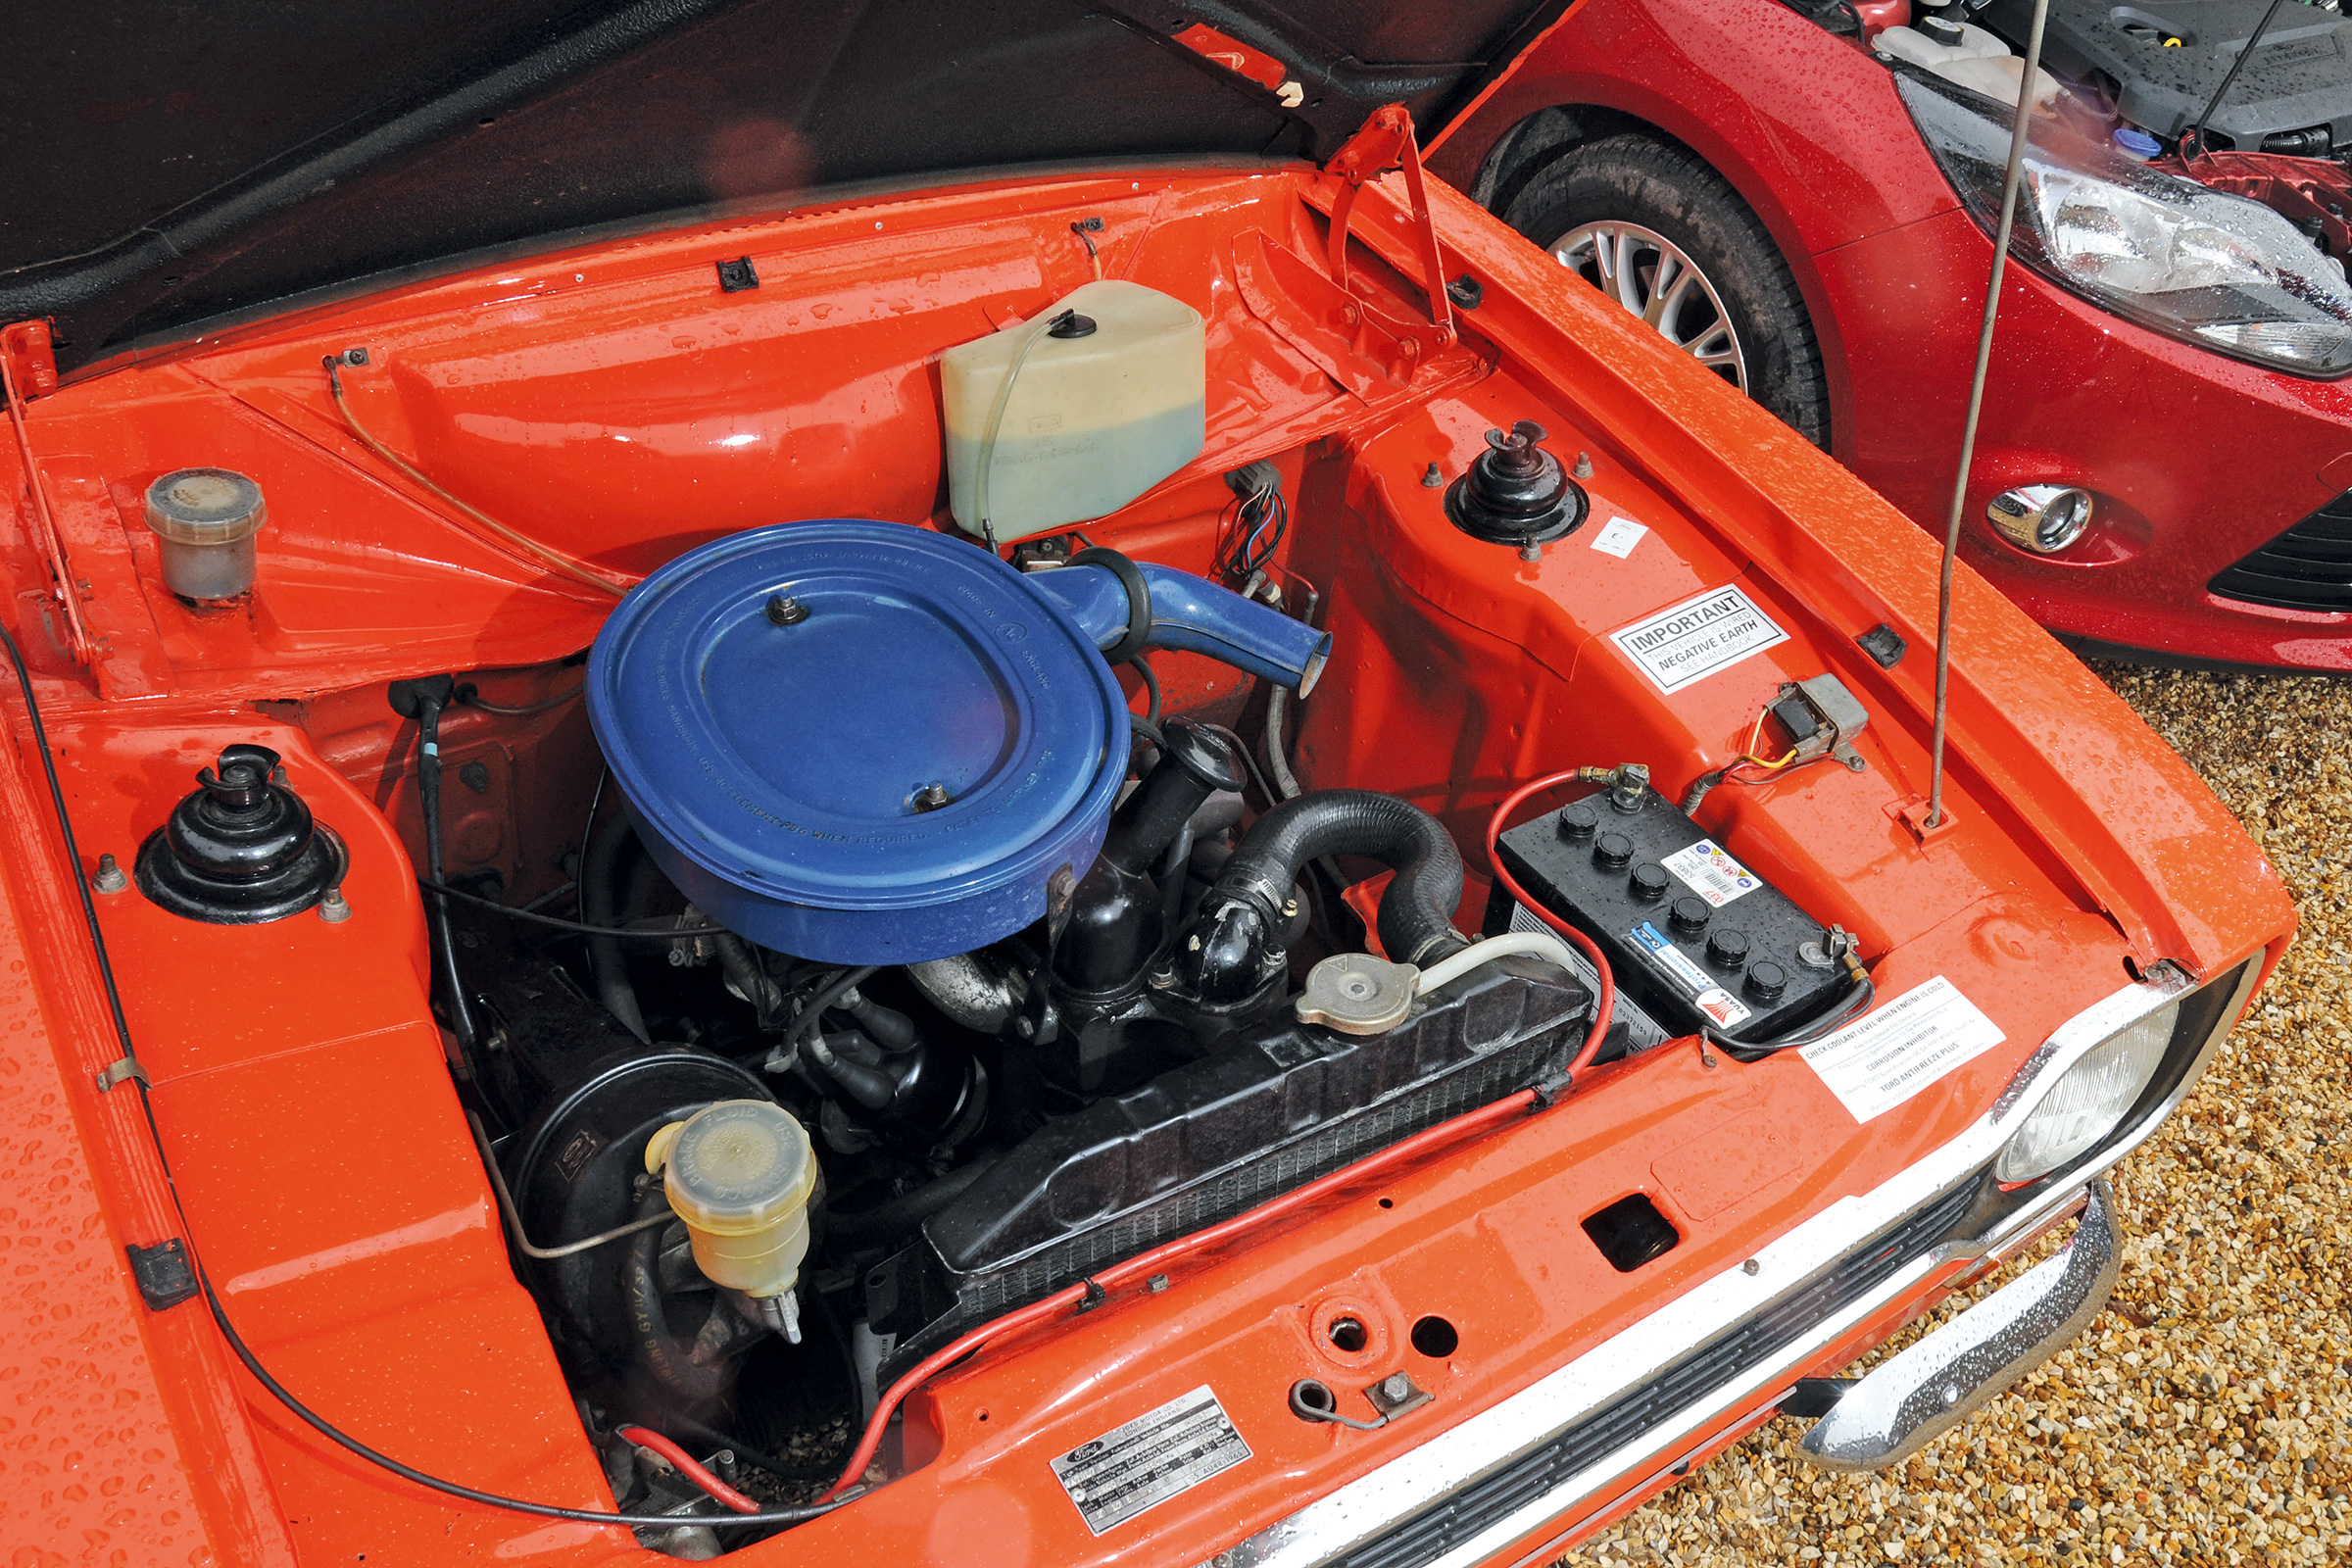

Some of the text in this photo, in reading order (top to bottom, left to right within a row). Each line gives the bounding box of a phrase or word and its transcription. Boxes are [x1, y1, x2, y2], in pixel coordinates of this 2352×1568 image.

[1631, 596, 1740, 651] IMPORTANT
[1647, 612, 1752, 662] THIS VEHICLE IS WIRED
[1658, 619, 1758, 670] NEGATIVE EARTH
[1681, 635, 1755, 673] SEE HANDBOOK
[1704, 888, 1725, 903] 037
[1657, 949, 1708, 989] Professional
[1717, 992, 1746, 1014] YUASA
[1804, 1044, 1829, 1060] CHECK
[1825, 1029, 1858, 1051] COOLANT
[1853, 1018, 1879, 1035] LEVEL
[1873, 1006, 1899, 1023] WHEN
[1894, 994, 1922, 1011] ENGINE
[1925, 980, 1946, 994] COLD
[1863, 1044, 1907, 1072] CORROSION
[1901, 1024, 1939, 1049] INHIBITOR
[1896, 1052, 1943, 1082] ANTIFREEZE
[678, 1132, 704, 1187] BRAKE
[703, 1106, 759, 1126] FLUID
[1138, 1408, 1162, 1424] MOTOR
[1075, 1444, 1098, 1460] Ford
